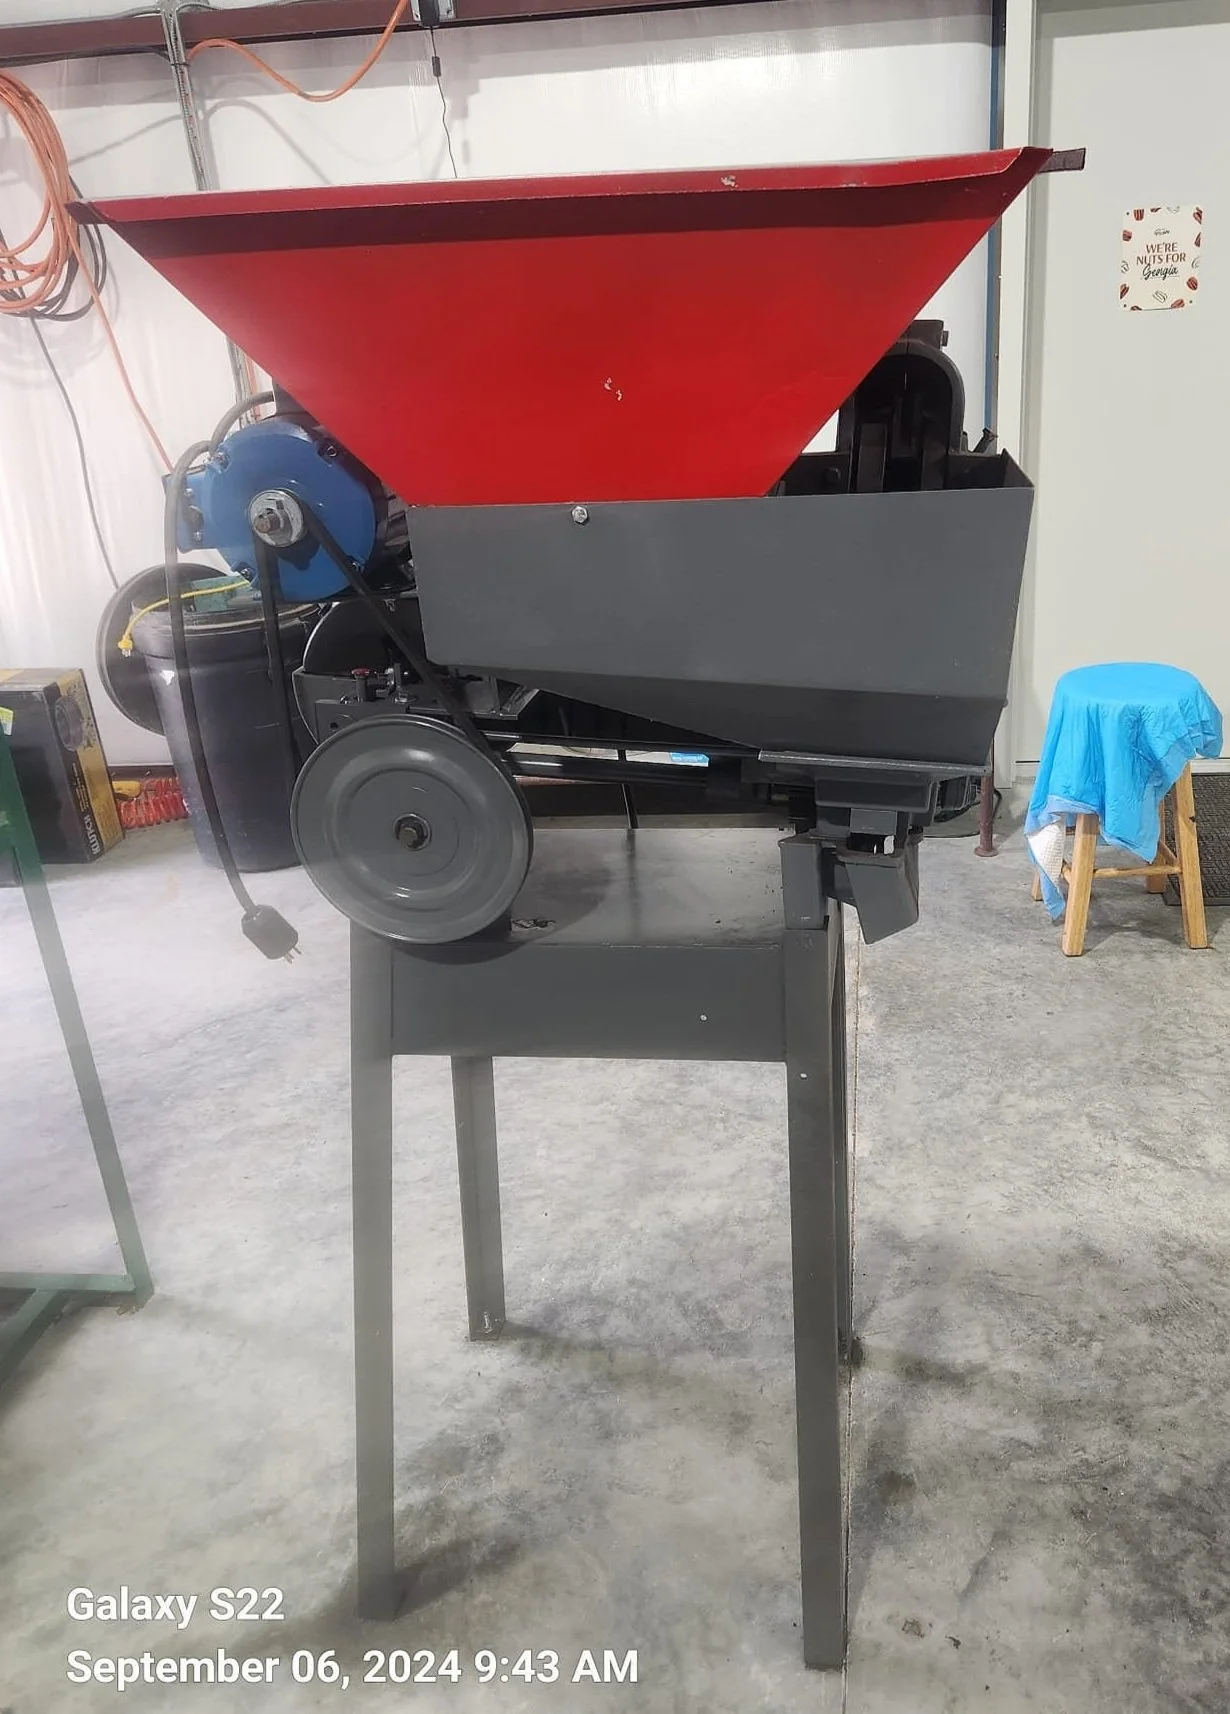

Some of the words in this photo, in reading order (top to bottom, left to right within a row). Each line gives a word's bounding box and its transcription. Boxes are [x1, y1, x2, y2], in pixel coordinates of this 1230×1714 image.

[1146, 242, 1178, 254] WE'RE
[1136, 254, 1164, 265] NUTS
[1166, 252, 1186, 263] FOR
[1142, 262, 1179, 280] Georgia
